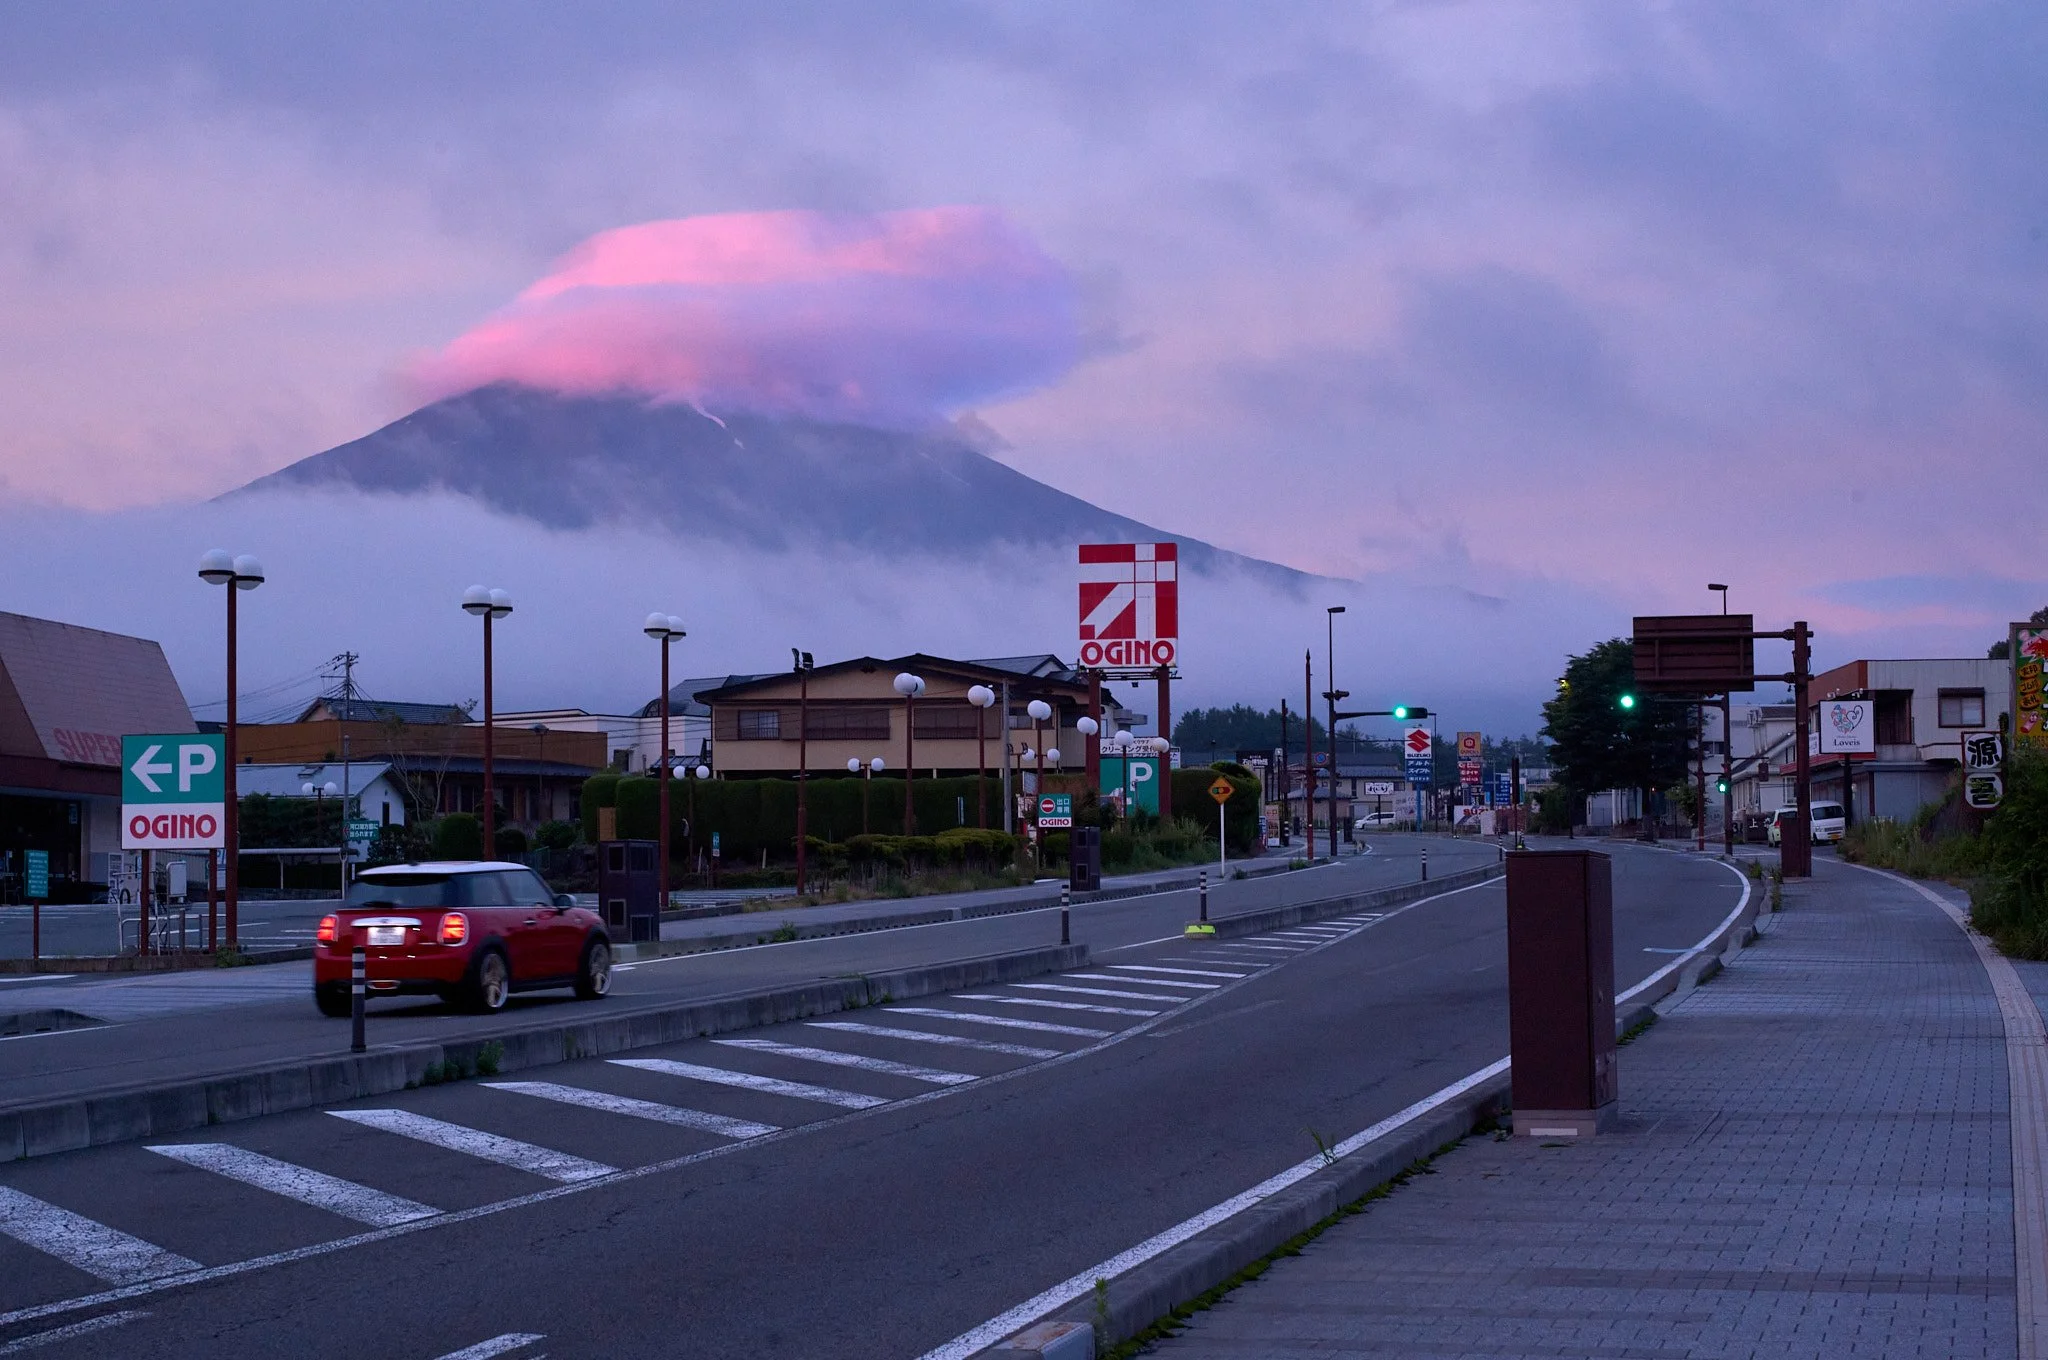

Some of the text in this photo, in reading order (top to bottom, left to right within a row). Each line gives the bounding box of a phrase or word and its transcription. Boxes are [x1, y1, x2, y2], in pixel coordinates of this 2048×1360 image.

[1081, 640, 1175, 666] OGINO
[178, 744, 217, 792] P
[1129, 762, 1153, 792] P
[130, 814, 217, 839] OGINO
[1040, 818, 1070, 826] OGINO
